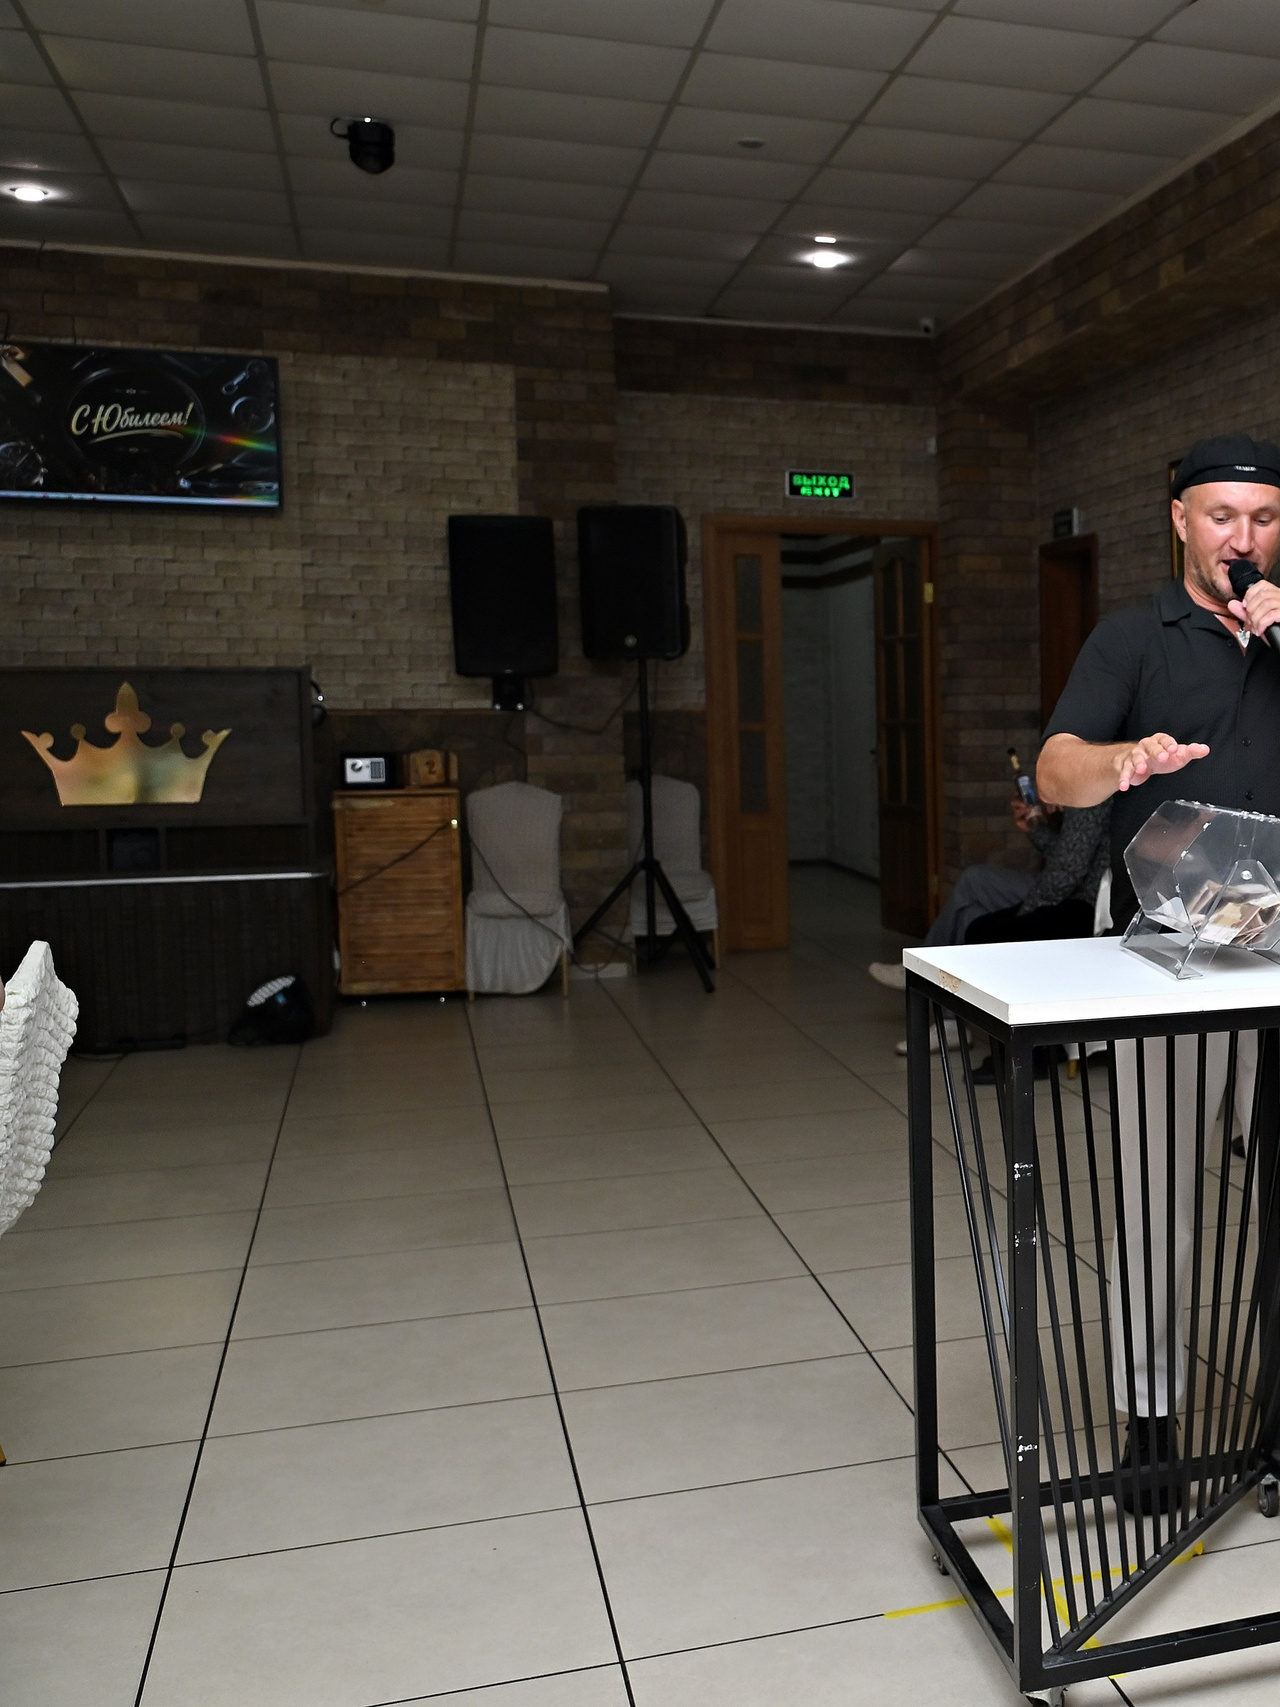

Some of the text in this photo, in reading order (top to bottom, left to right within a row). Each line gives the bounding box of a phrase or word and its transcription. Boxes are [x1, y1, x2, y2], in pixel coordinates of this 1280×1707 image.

[71, 402, 194, 435] С Юбилеем!
[792, 474, 850, 490] ВЫХОД
